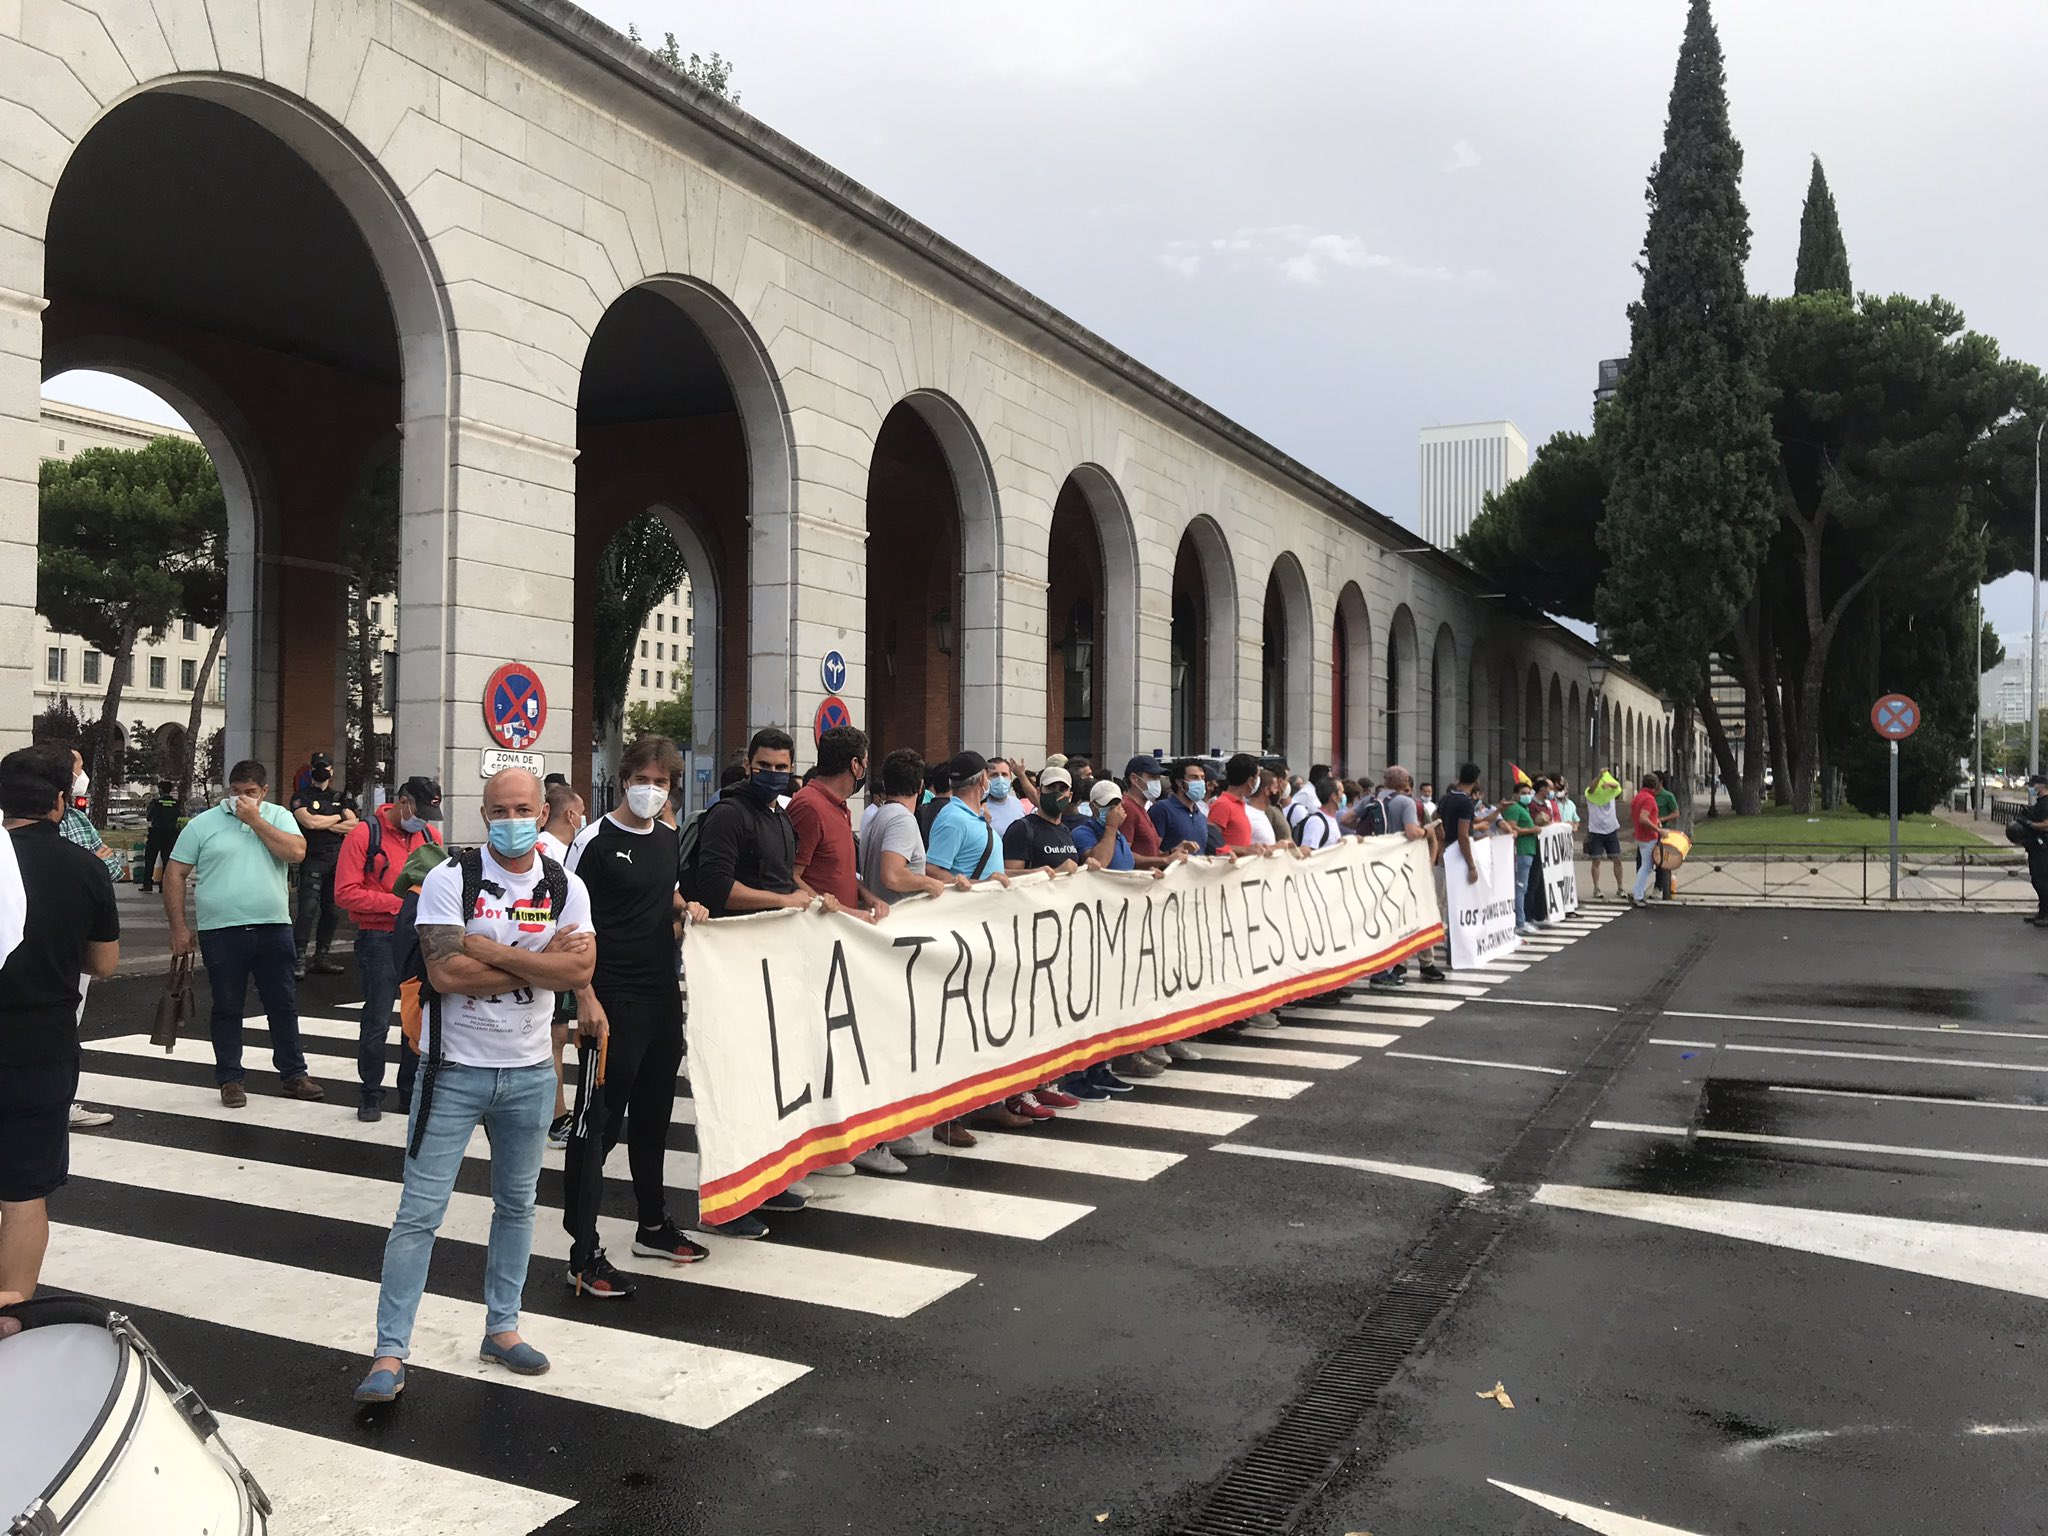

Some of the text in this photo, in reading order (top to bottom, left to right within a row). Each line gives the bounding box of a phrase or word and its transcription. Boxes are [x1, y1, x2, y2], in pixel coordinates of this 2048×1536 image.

[496, 753, 533, 764] ZONA DE
[1044, 845, 1060, 854] Out
[1060, 845, 1067, 854] of
[1460, 909, 1479, 926] LOS
[761, 860, 1419, 1121] LA TAUROMAQUIA ES CULTURA
